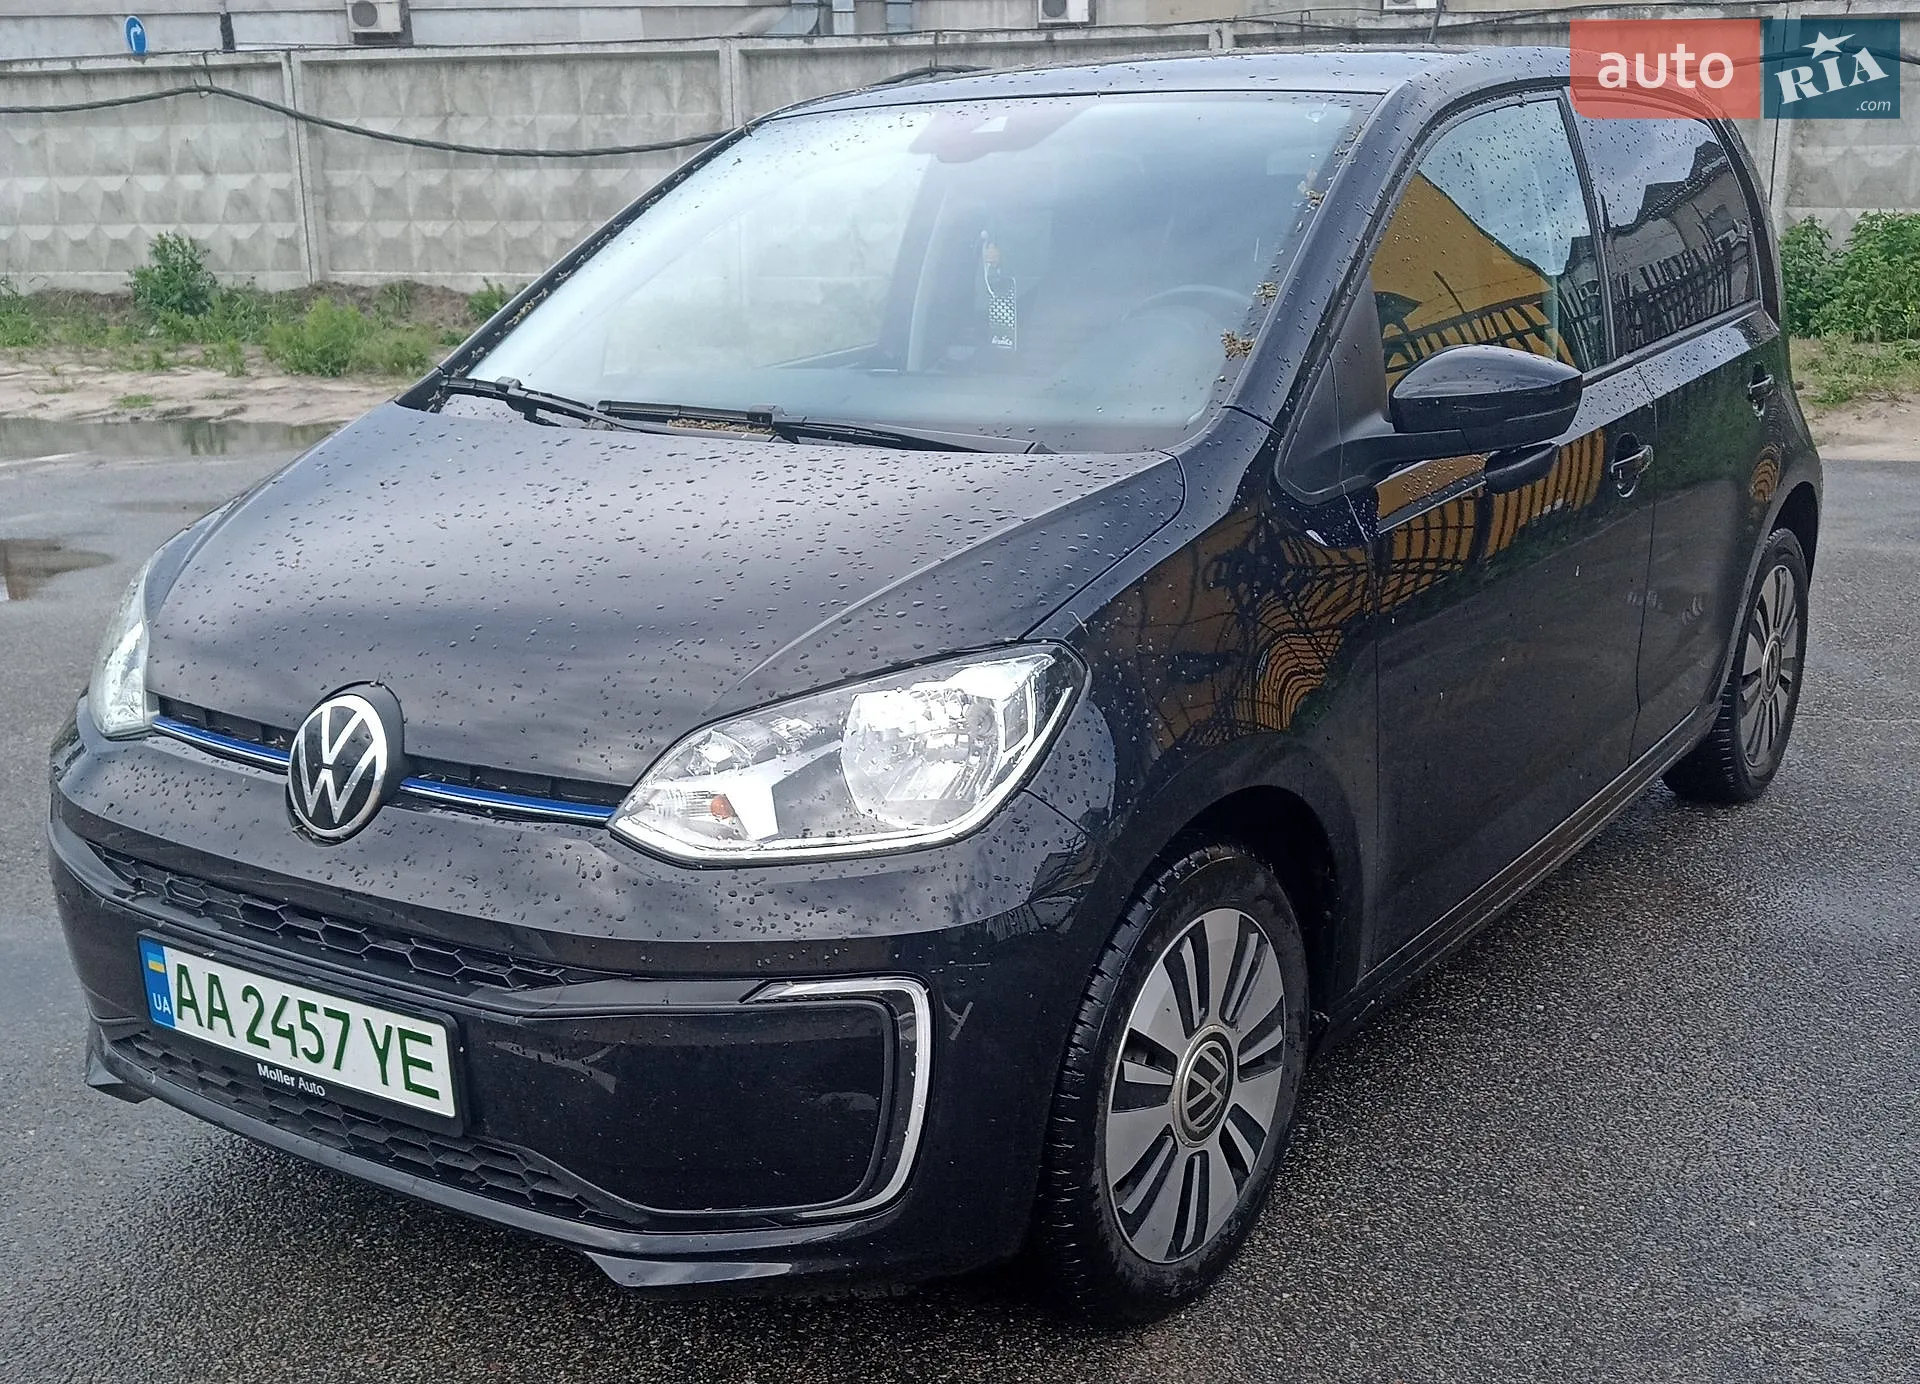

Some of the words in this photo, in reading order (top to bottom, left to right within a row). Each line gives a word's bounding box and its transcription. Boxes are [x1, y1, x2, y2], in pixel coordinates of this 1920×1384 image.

[152, 992, 171, 1015] UA
[176, 963, 236, 1038] AA
[241, 985, 350, 1071] 2457
[363, 1017, 440, 1100] YE
[257, 1062, 295, 1087] Moller
[298, 1076, 326, 1097] Auto
